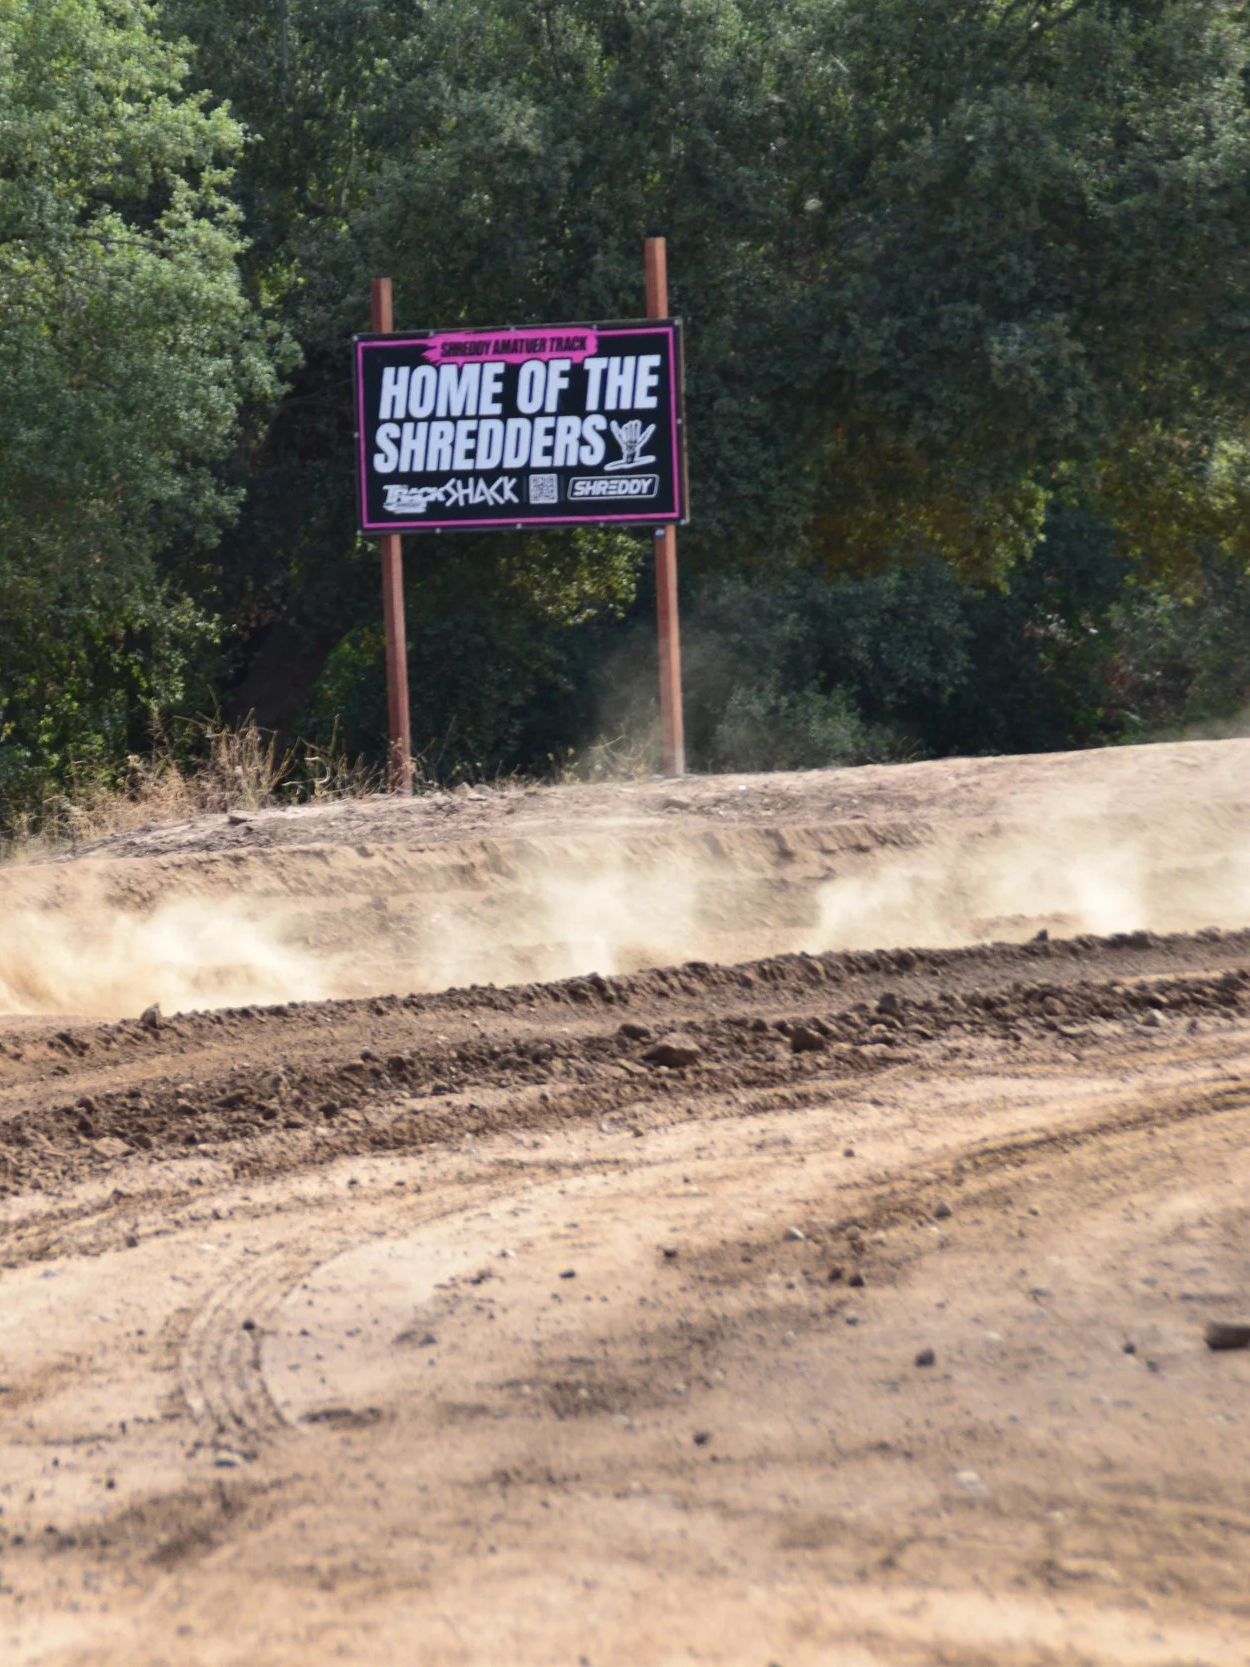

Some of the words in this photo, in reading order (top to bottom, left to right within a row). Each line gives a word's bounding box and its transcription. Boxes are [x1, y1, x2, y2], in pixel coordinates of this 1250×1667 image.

[440, 339, 491, 357] SHREDDY
[549, 335, 588, 353] TRACK
[378, 361, 505, 420] HOME
[516, 358, 572, 414] OF
[583, 353, 661, 411] THE
[373, 413, 607, 473] SHREDDERS
[573, 477, 653, 497] SHREDDY
